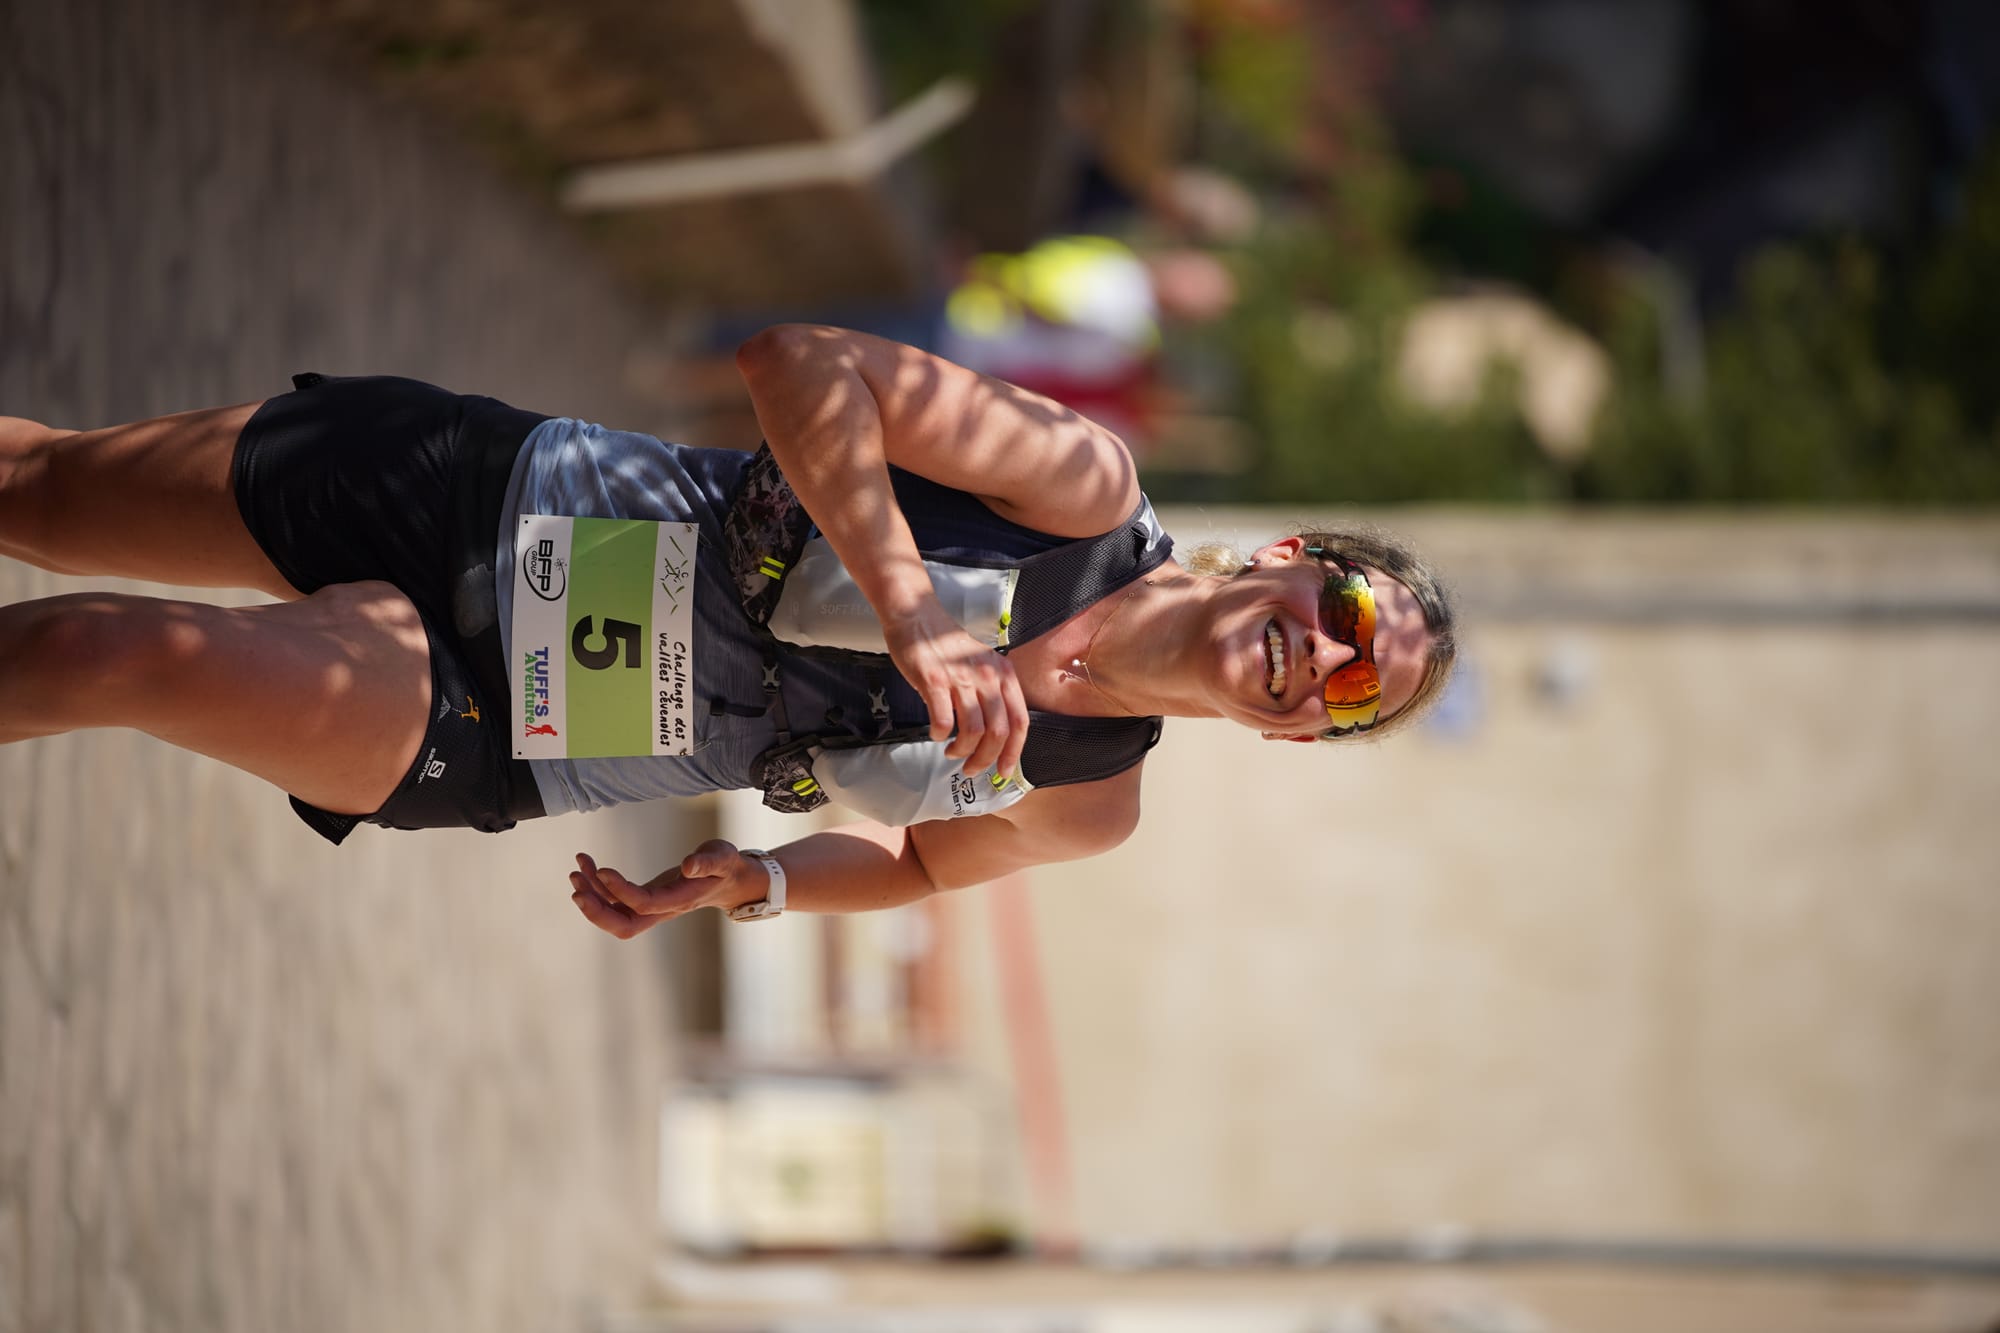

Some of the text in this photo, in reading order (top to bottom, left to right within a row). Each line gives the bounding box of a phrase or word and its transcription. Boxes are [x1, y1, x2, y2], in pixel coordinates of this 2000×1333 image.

[530, 550, 538, 576] GROUP
[536, 539, 554, 592] BFP
[571, 614, 642, 671] 5
[524, 652, 538, 724] Aventure
[534, 646, 549, 717] TUFF'S
[658, 632, 672, 747] vallées cévenoles
[669, 641, 687, 740] Challenge des
